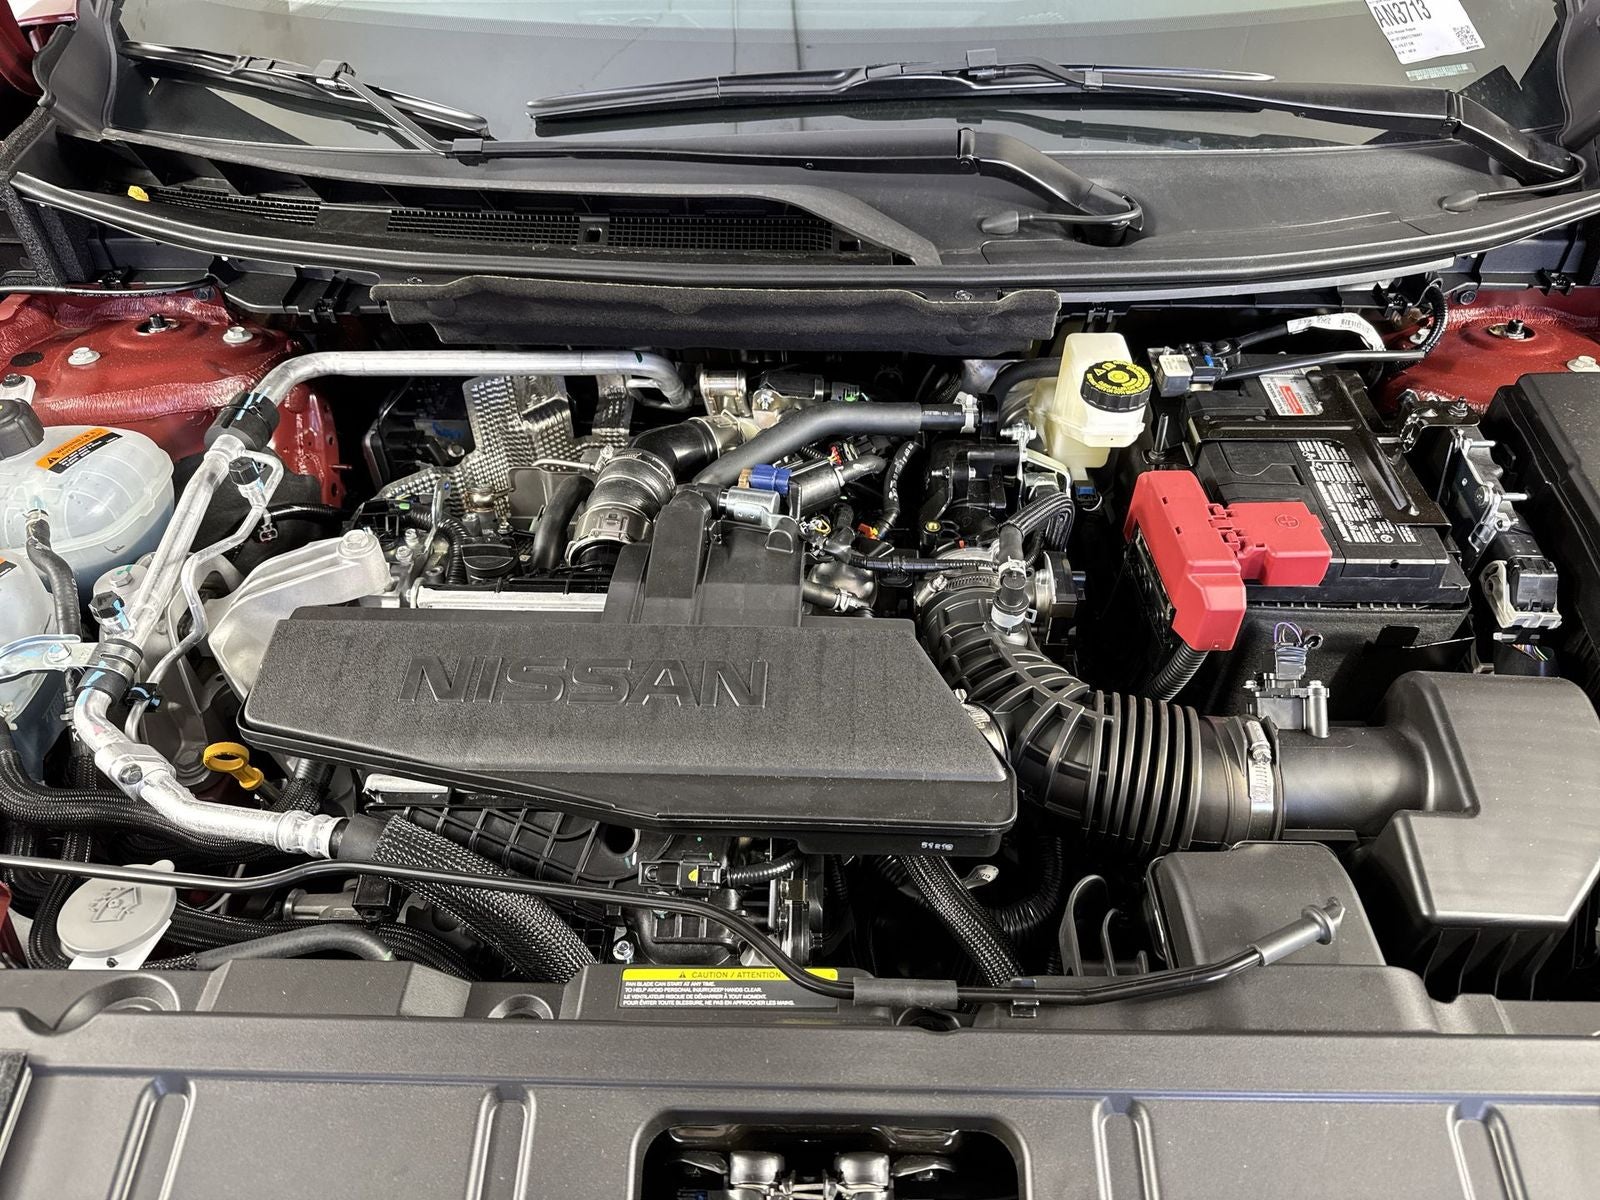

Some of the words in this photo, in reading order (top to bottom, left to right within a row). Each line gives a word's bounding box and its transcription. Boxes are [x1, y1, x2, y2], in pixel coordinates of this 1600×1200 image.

[1373, 0, 1432, 28] AN3713
[397, 655, 769, 709] NISSAN
[691, 971, 728, 979] CAUTION
[737, 971, 781, 979] ATTENTION
